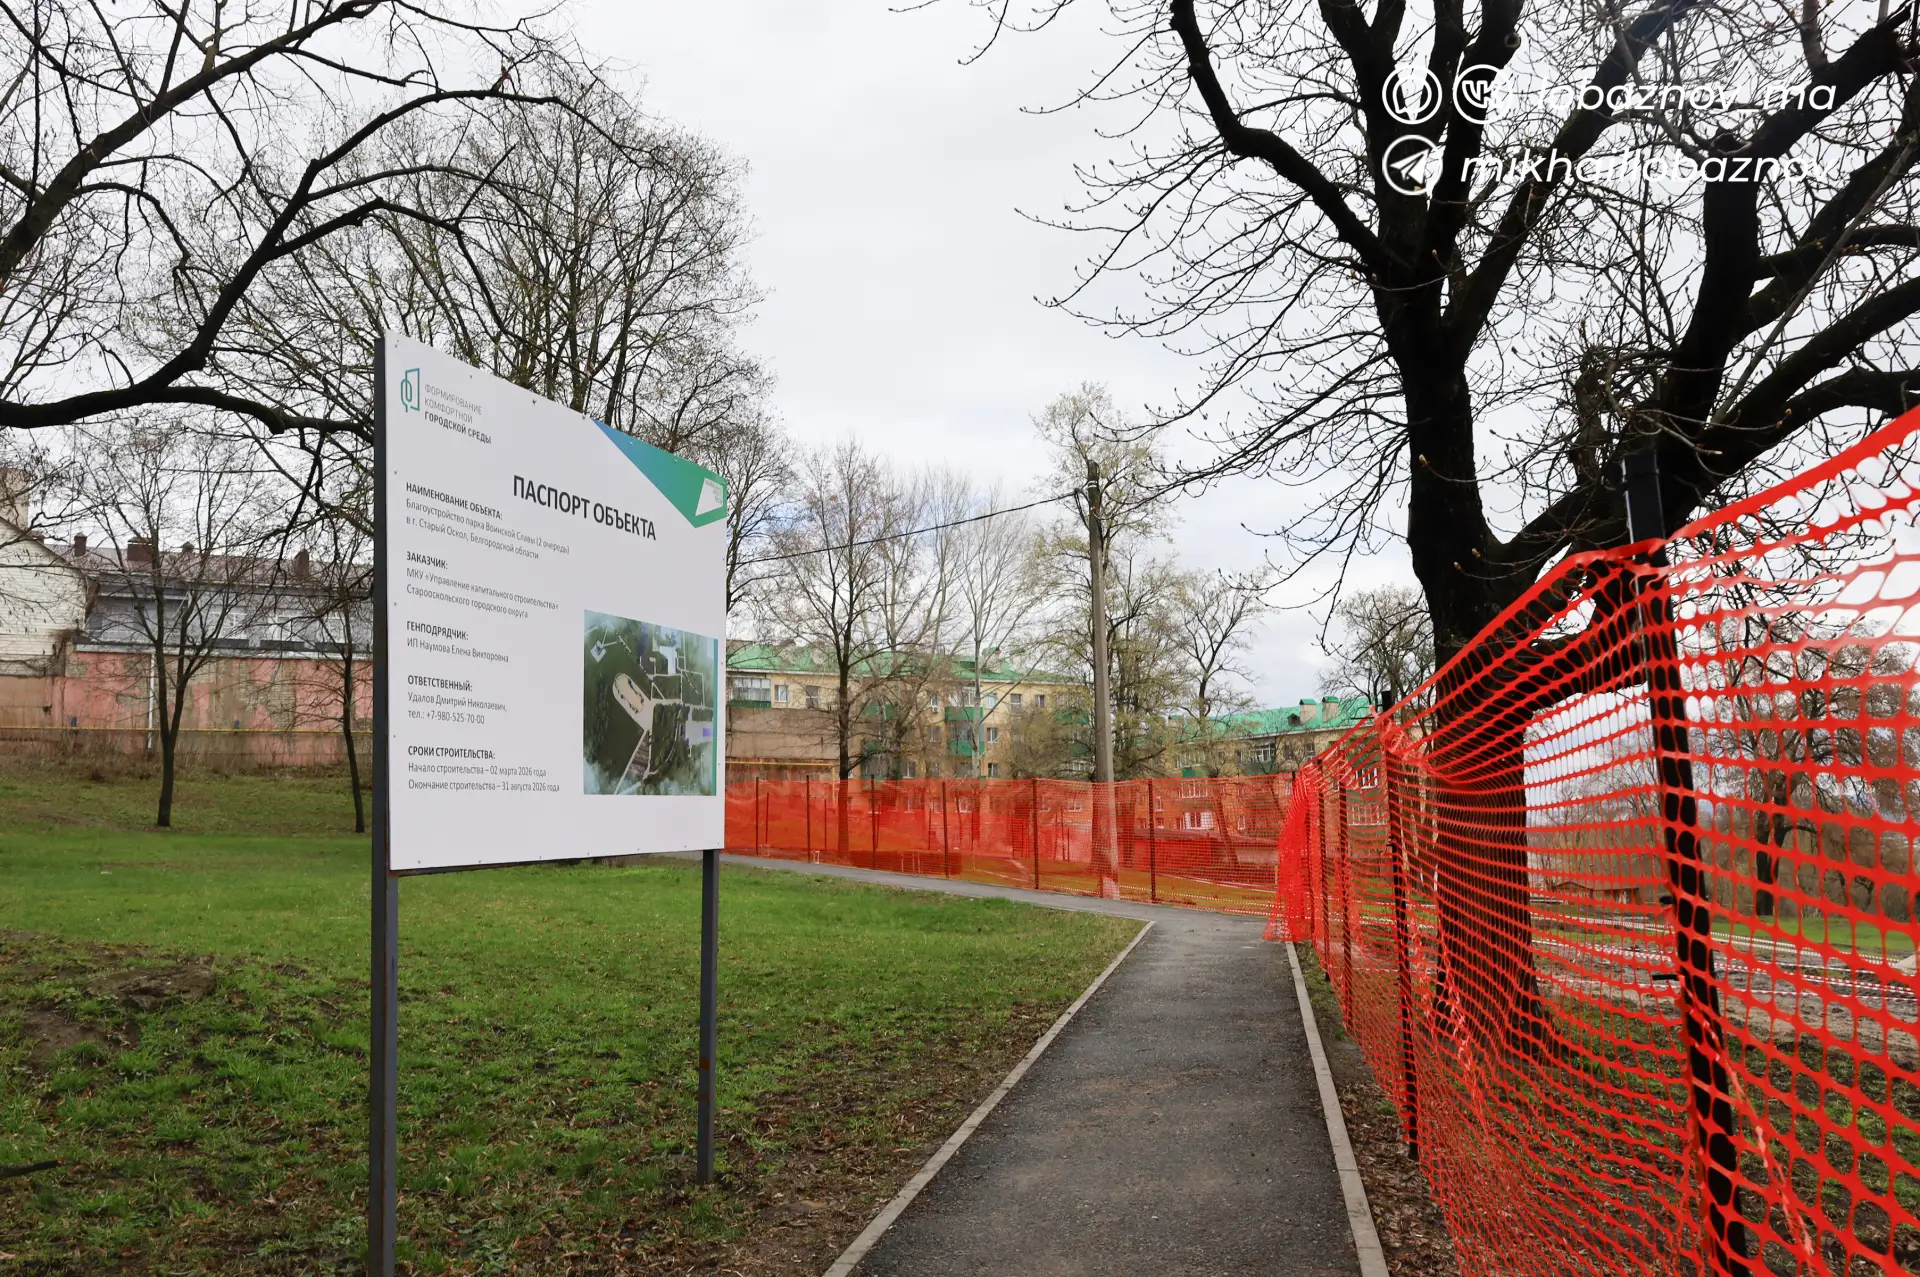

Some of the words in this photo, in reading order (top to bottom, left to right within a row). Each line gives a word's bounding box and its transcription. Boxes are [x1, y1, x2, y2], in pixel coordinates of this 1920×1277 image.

[424, 384, 483, 415] ФОРМИРОВАНИЕ
[424, 397, 473, 424] КОМФОРТНОЙ
[424, 411, 466, 434] ГОРОДСКОЙ
[468, 428, 491, 444] СРЕДЫ
[406, 482, 468, 509] НАИМЕНОВАНИЕ
[469, 502, 503, 520] ОБЪЕКТА:
[514, 475, 590, 519] ПАСПОРТ
[594, 503, 656, 540] ОБЪЕКТА
[406, 498, 465, 524] Благоустройство
[466, 517, 485, 530] парка
[486, 521, 516, 539] Воинской
[517, 532, 535, 544] Славы
[536, 536, 542, 547] (2
[543, 540, 570, 555] очередь)
[406, 516, 410, 524] в
[412, 518, 417, 526] г.
[419, 518, 445, 533] Старый
[447, 526, 469, 542] Оскол,
[470, 532, 514, 552] Белгородской
[515, 546, 539, 560] области
[406, 551, 448, 570] ЗАКАЗЧИК:
[406, 568, 424, 580] МКУ
[425, 573, 470, 591] «Управление
[471, 584, 513, 601] капитального
[406, 584, 470, 606] Старооскольского
[471, 601, 507, 614] городского
[508, 609, 528, 619] округа
[406, 620, 469, 641] ГЕНПОДРЯДЧИК:
[407, 638, 418, 648] ИП
[420, 640, 450, 654] Наумова
[451, 645, 471, 657] Елена
[472, 648, 509, 663] Викторовна
[407, 675, 473, 692] ОТВЕТСТВЕННЫЙ:
[408, 691, 435, 704] Удалов
[436, 695, 467, 708] Дмитрий
[467, 699, 507, 712] Николаевич,
[408, 709, 425, 719] тел.:
[426, 710, 485, 724] +7-980-525-70-00
[408, 745, 434, 756] СРОКИ
[436, 747, 495, 759] СТРОИТЕЛЬСТВА:
[408, 763, 435, 773] Начало
[437, 765, 484, 775] строительства
[490, 765, 498, 775] 02
[500, 768, 517, 777] марта
[519, 767, 532, 776] 2026
[533, 769, 546, 777] года
[408, 779, 448, 790] Окончание
[449, 781, 495, 792] строительства
[502, 782, 509, 790] 31
[510, 784, 531, 792] августа
[532, 783, 546, 791] 2026
[547, 784, 560, 792] года
